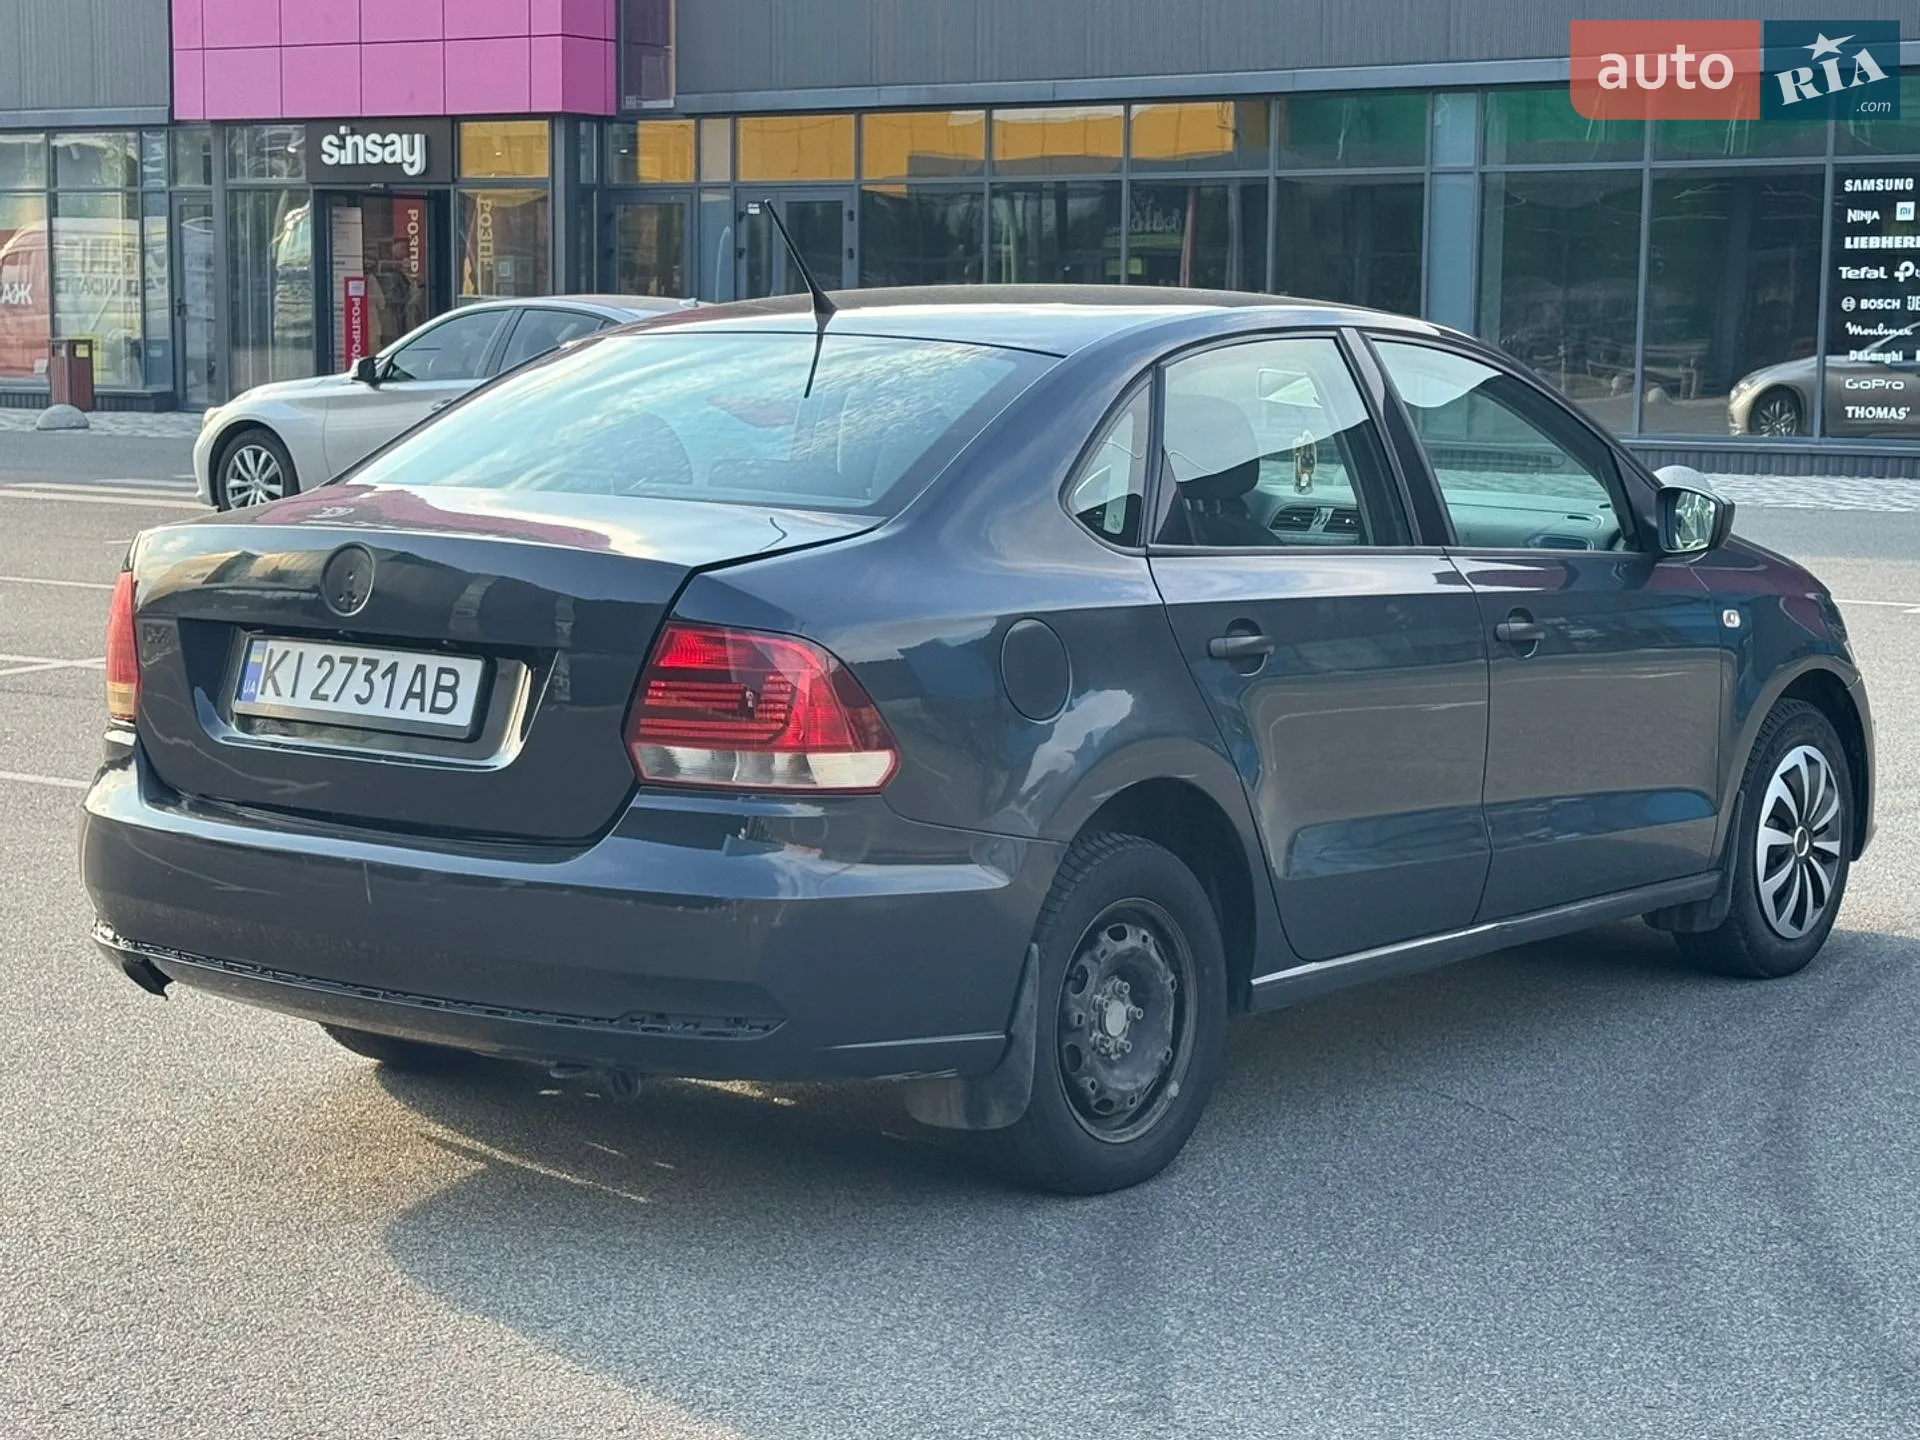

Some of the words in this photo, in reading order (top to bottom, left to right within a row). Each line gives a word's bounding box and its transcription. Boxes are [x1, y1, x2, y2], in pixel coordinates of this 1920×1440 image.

[321, 125, 427, 176] sinsay
[1844, 178, 1914, 192] SAMSUNG
[1838, 266, 1888, 279] Tefal
[1860, 298, 1900, 310] BOSCH
[1845, 378, 1905, 390] GoPro
